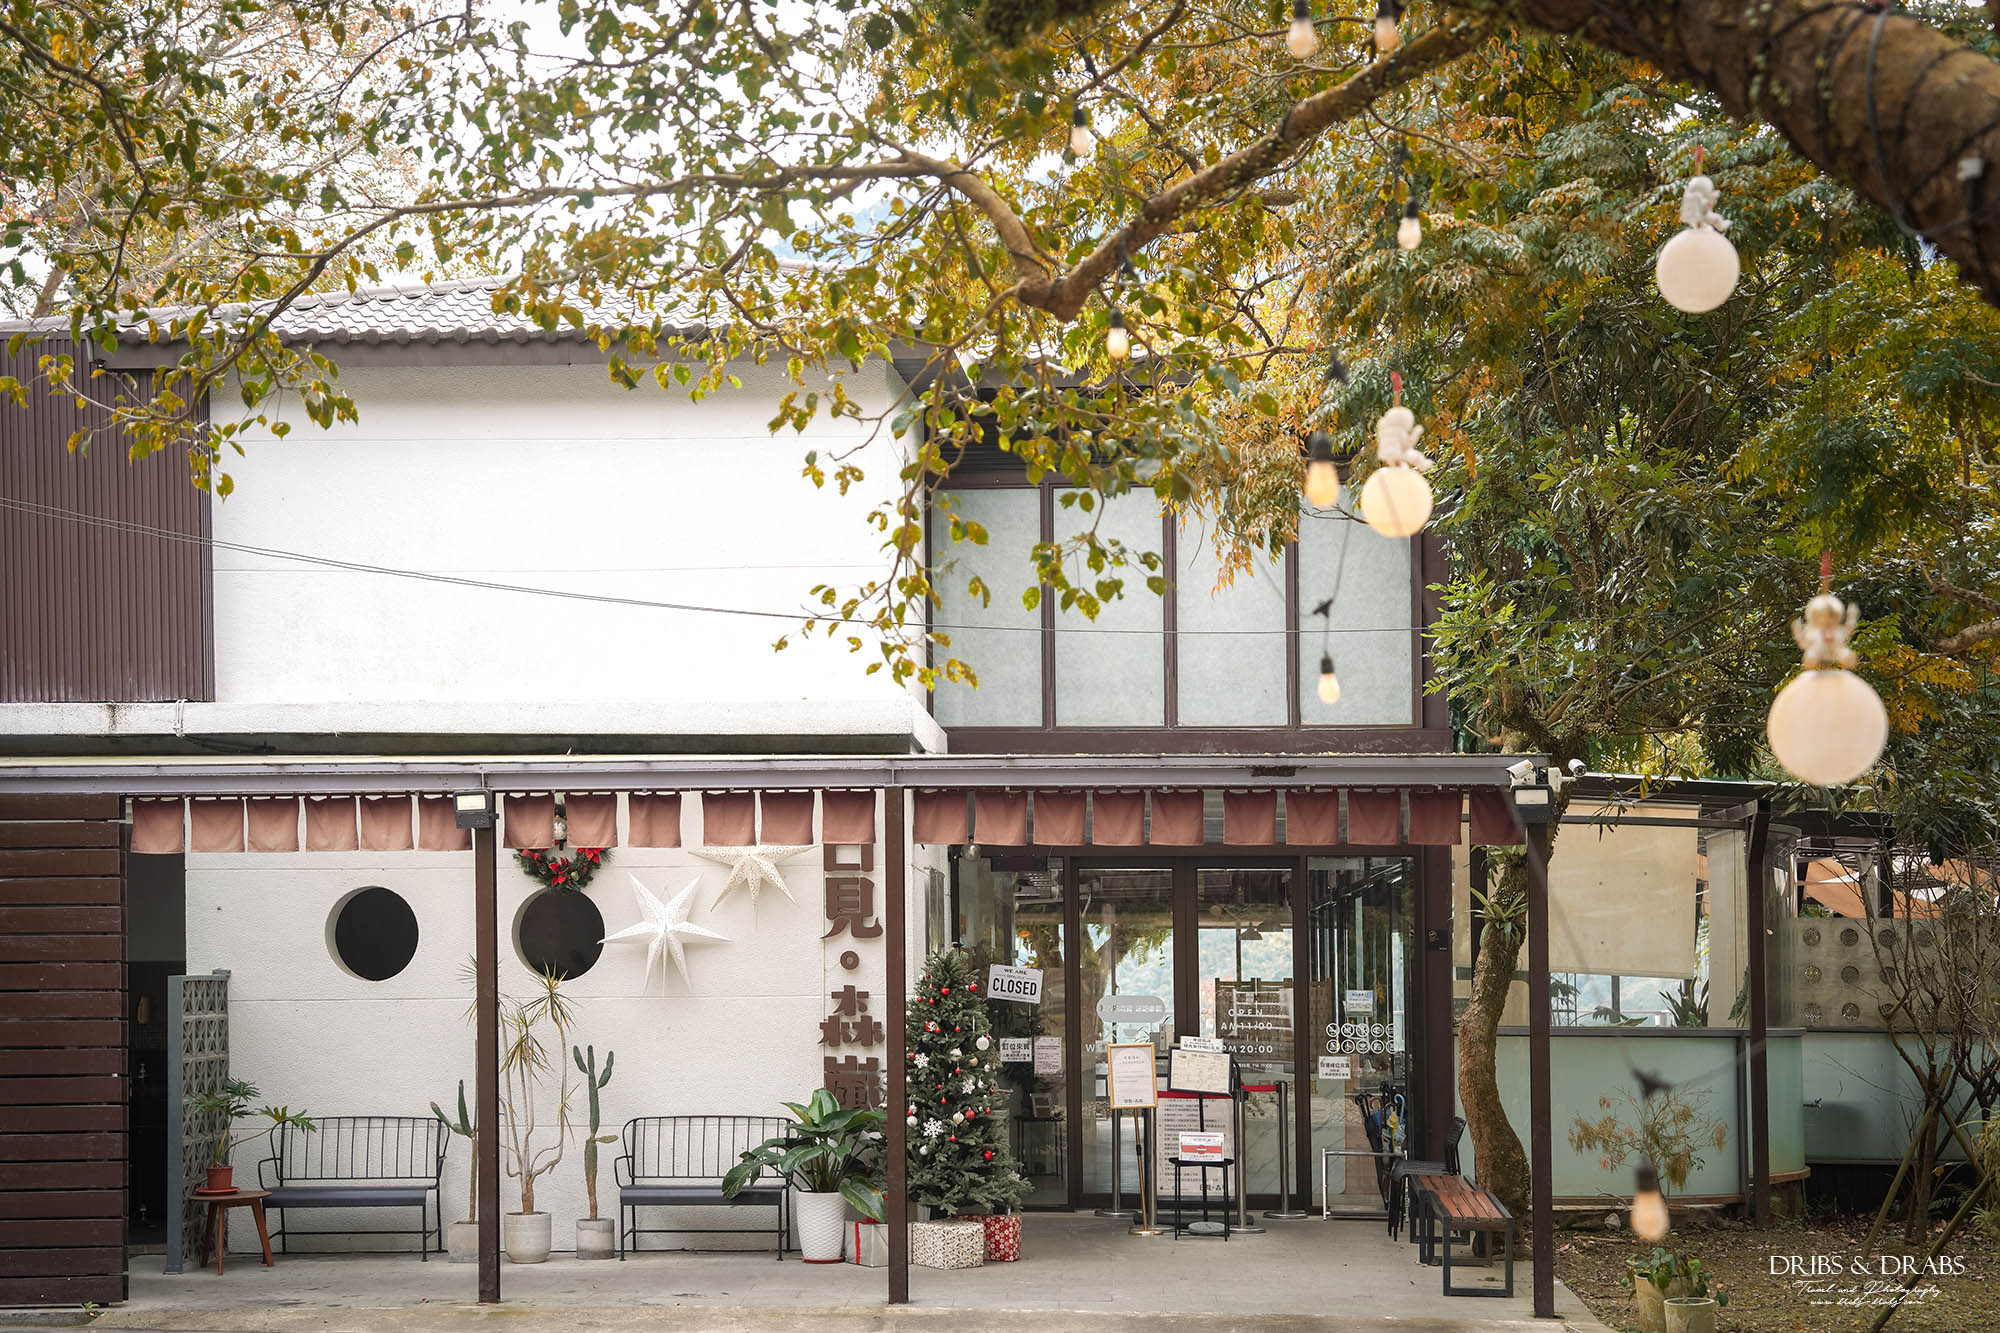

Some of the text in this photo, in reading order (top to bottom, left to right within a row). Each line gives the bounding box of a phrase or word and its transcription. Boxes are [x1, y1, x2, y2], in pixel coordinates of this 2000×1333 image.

[992, 977, 1037, 996] CLOSED
[1228, 1008, 1263, 1017] OPEN
[1240, 1045, 1273, 1054] 20:00
